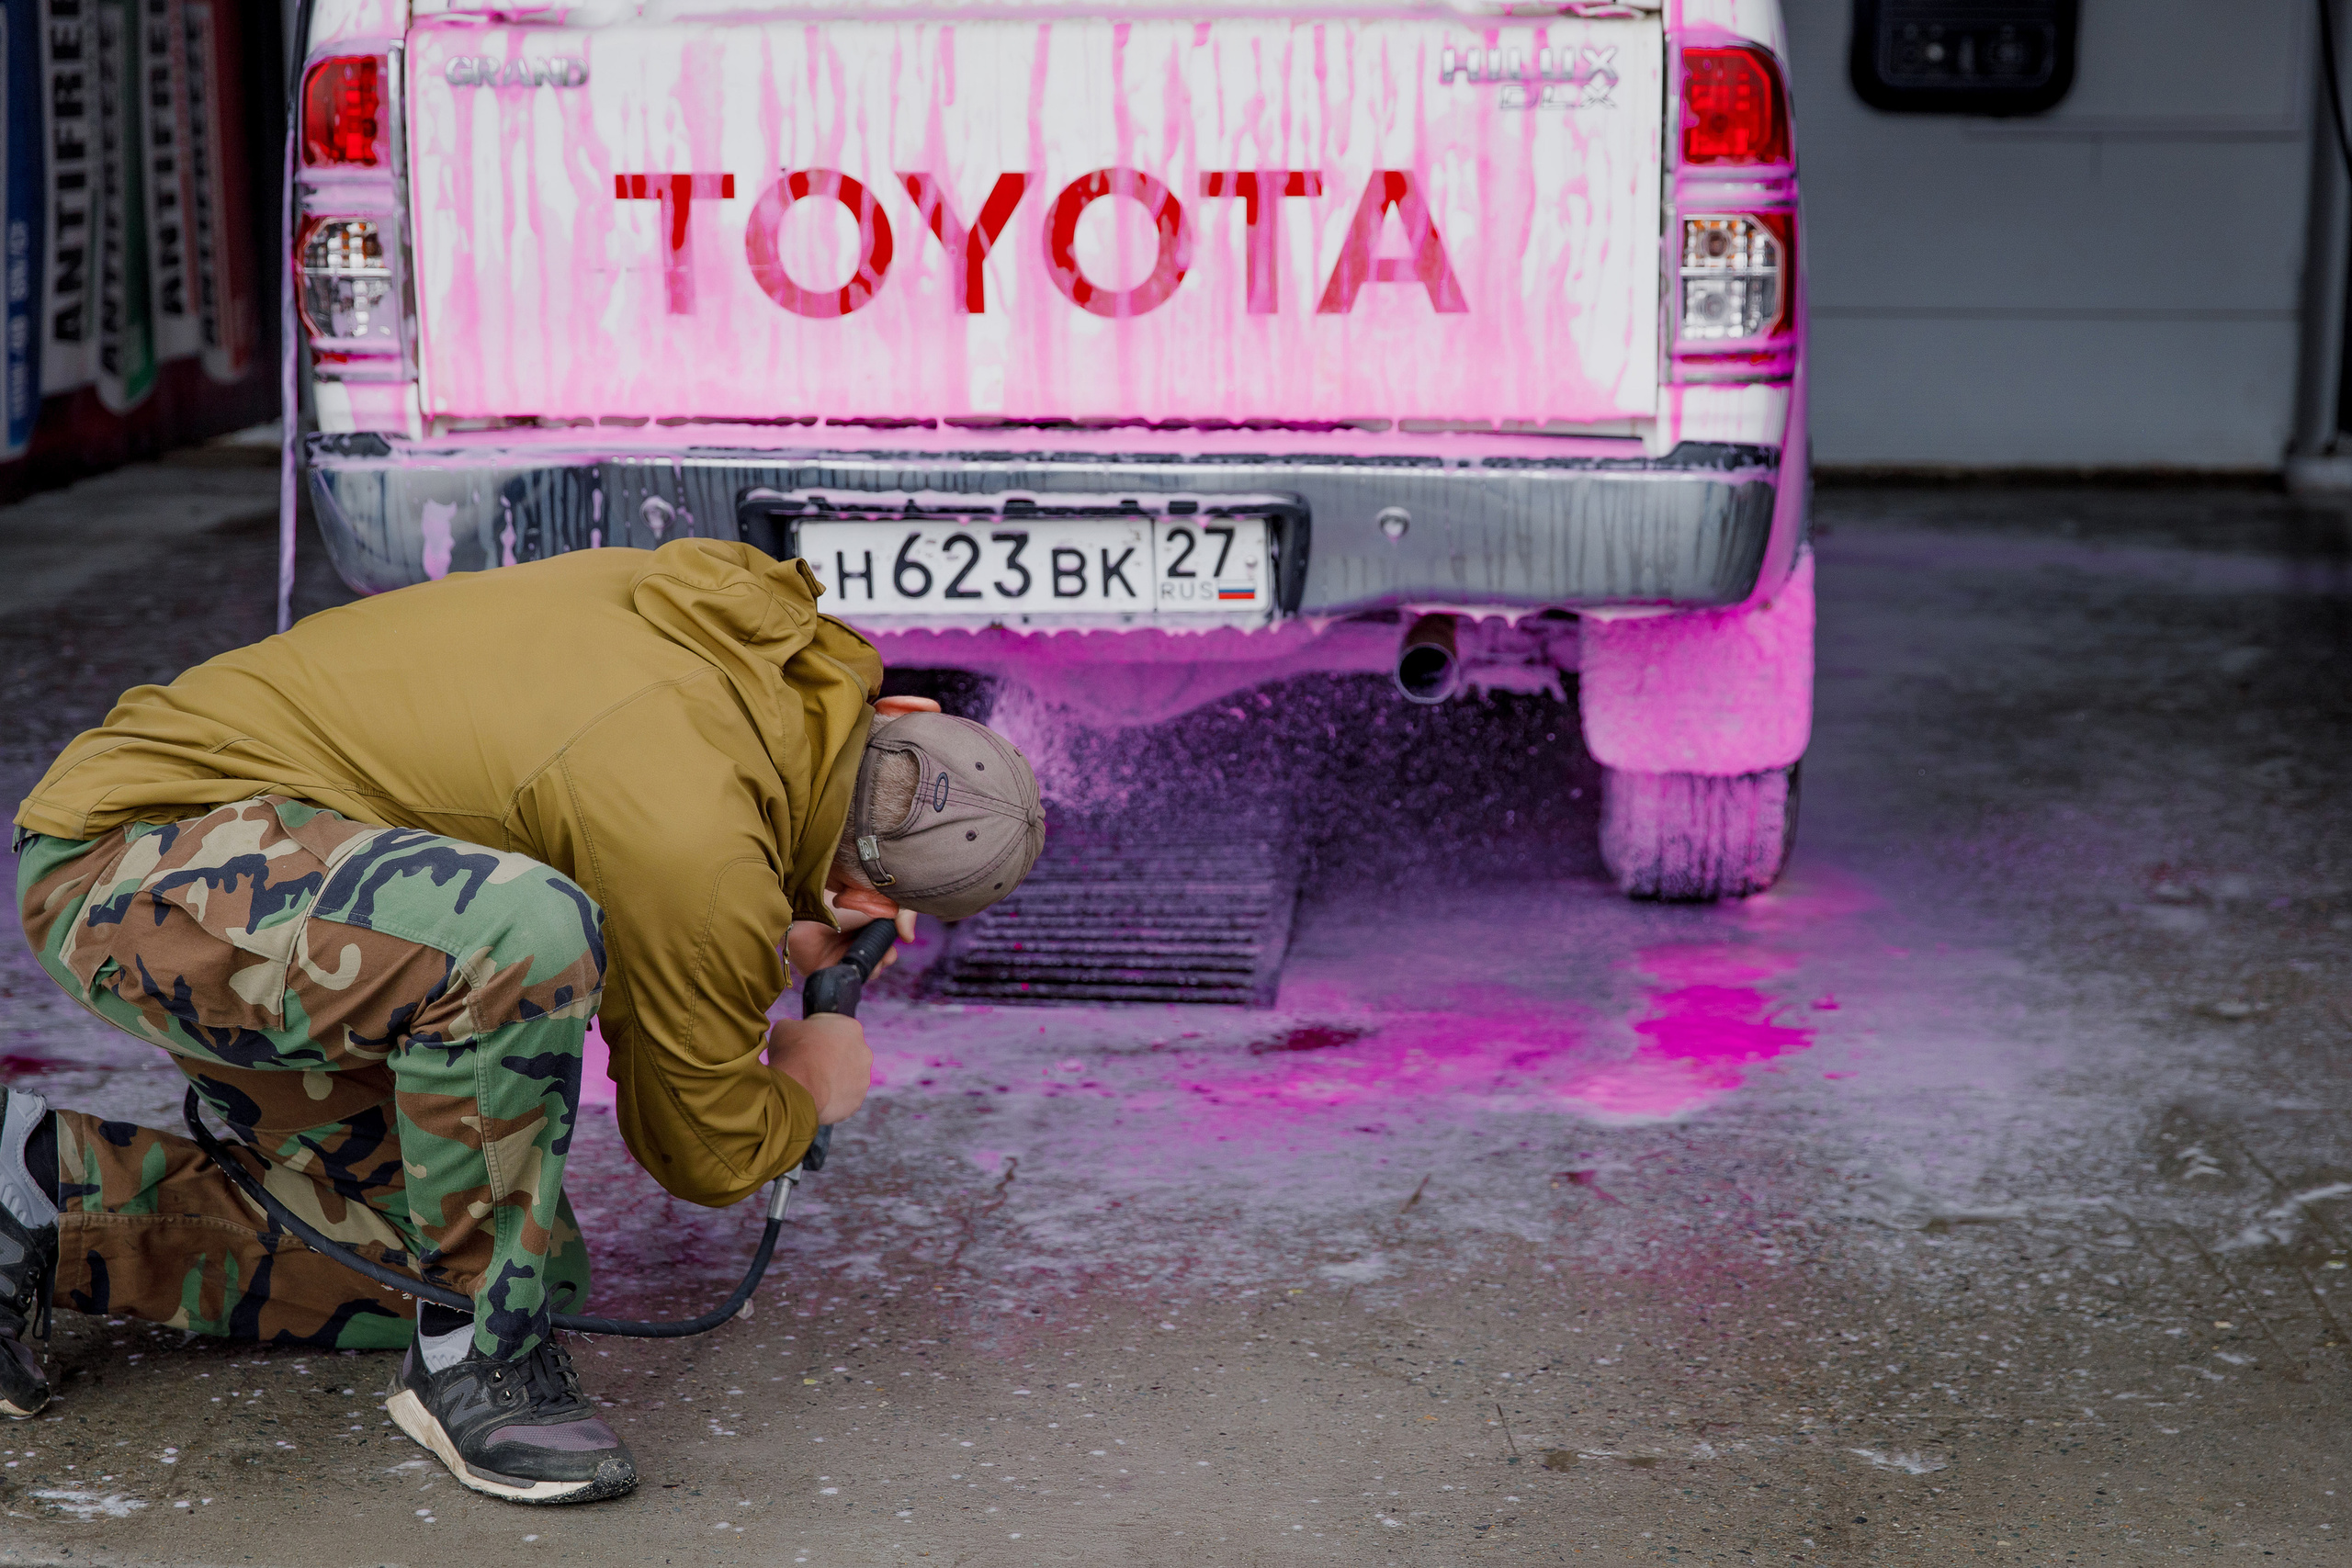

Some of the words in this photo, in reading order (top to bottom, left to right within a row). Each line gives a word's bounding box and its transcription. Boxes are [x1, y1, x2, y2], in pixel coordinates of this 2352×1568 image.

[445, 56, 590, 88] GRAND
[1440, 47, 1620, 84] HILUX
[615, 166, 1469, 320] TOYOTA
[1166, 527, 1237, 578] 27
[1160, 581, 1215, 602] RUS
